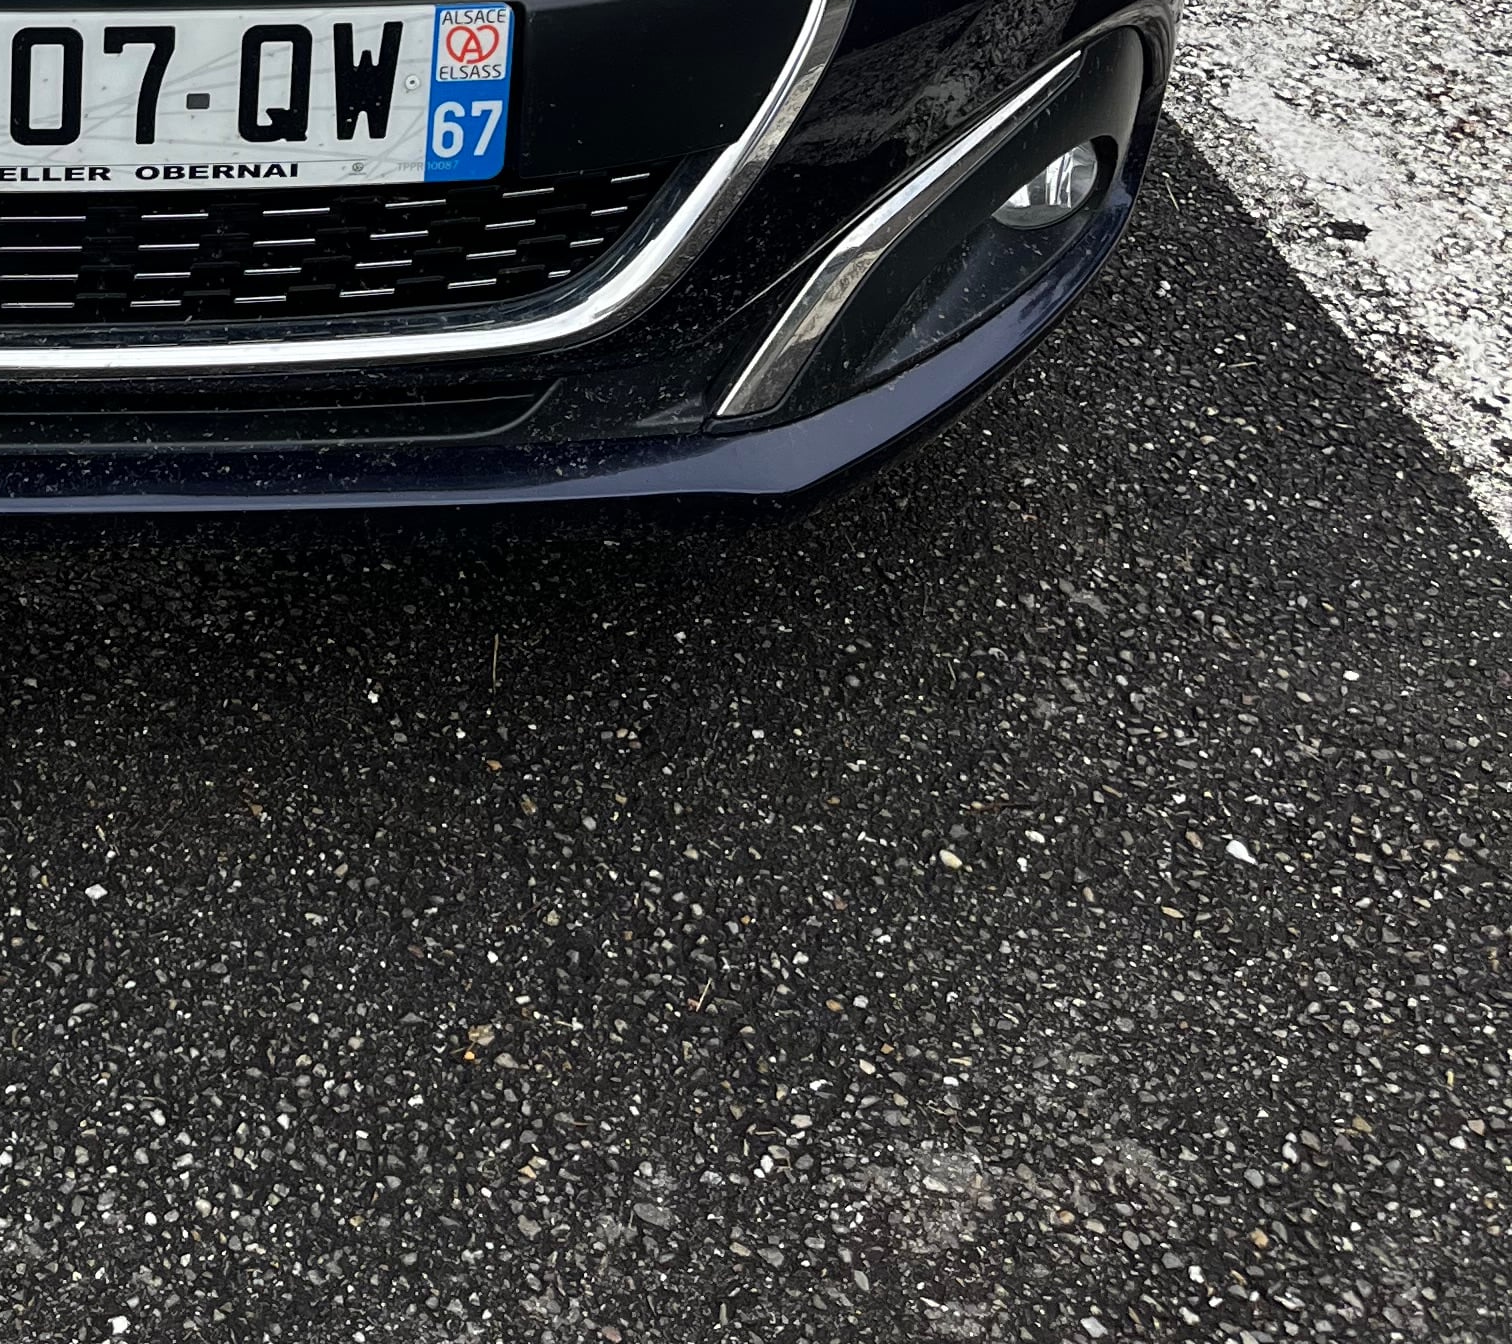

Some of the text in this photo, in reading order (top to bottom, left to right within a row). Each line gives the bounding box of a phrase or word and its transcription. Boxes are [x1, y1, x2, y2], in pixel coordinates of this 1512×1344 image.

[441, 9, 506, 25] ALSACE
[439, 64, 502, 80] ELSASS
[432, 100, 503, 158] 67
[135, 162, 299, 180] OBERNAI
